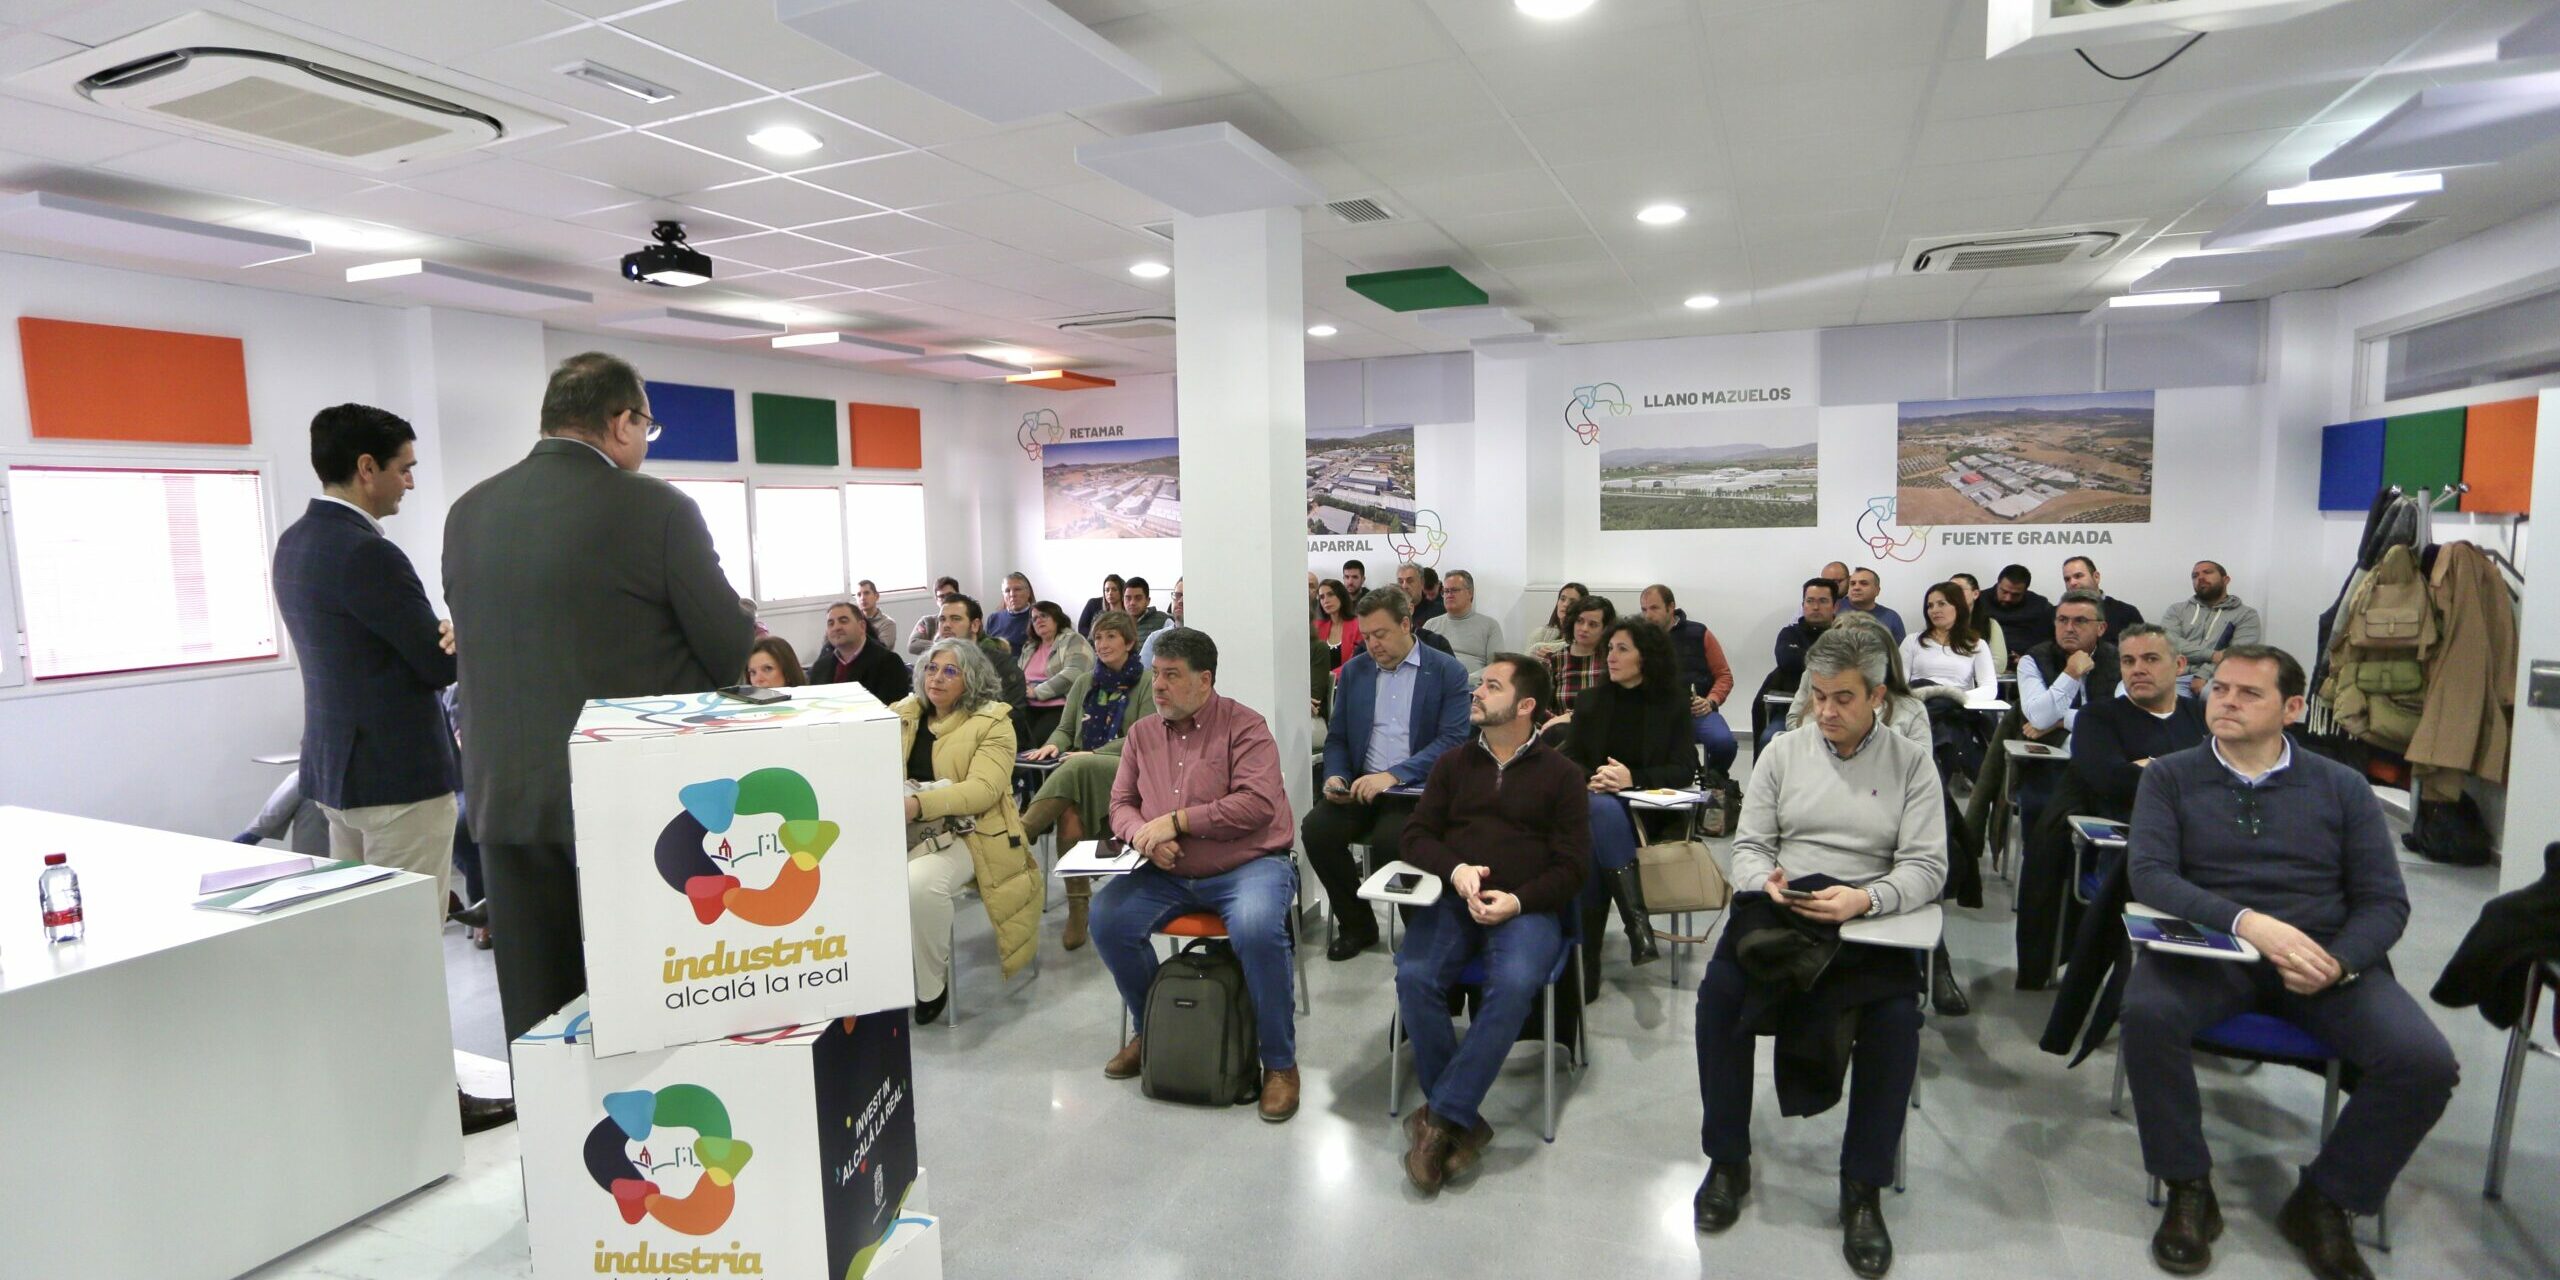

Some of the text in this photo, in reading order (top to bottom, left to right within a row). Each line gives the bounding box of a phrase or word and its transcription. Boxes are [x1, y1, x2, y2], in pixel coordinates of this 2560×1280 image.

[1643, 387, 1791, 408] LLANO MAZUELOS
[1070, 425, 1124, 439] RETAMAR
[1941, 530, 2113, 545] FUENTE GRANADA
[662, 926, 848, 984] industria
[665, 961, 849, 1010] alcalá la real
[855, 1076, 891, 1139] INVEST IN
[842, 1085, 903, 1187] ALCALÁ LA REAL
[593, 1239, 764, 1275] industria
